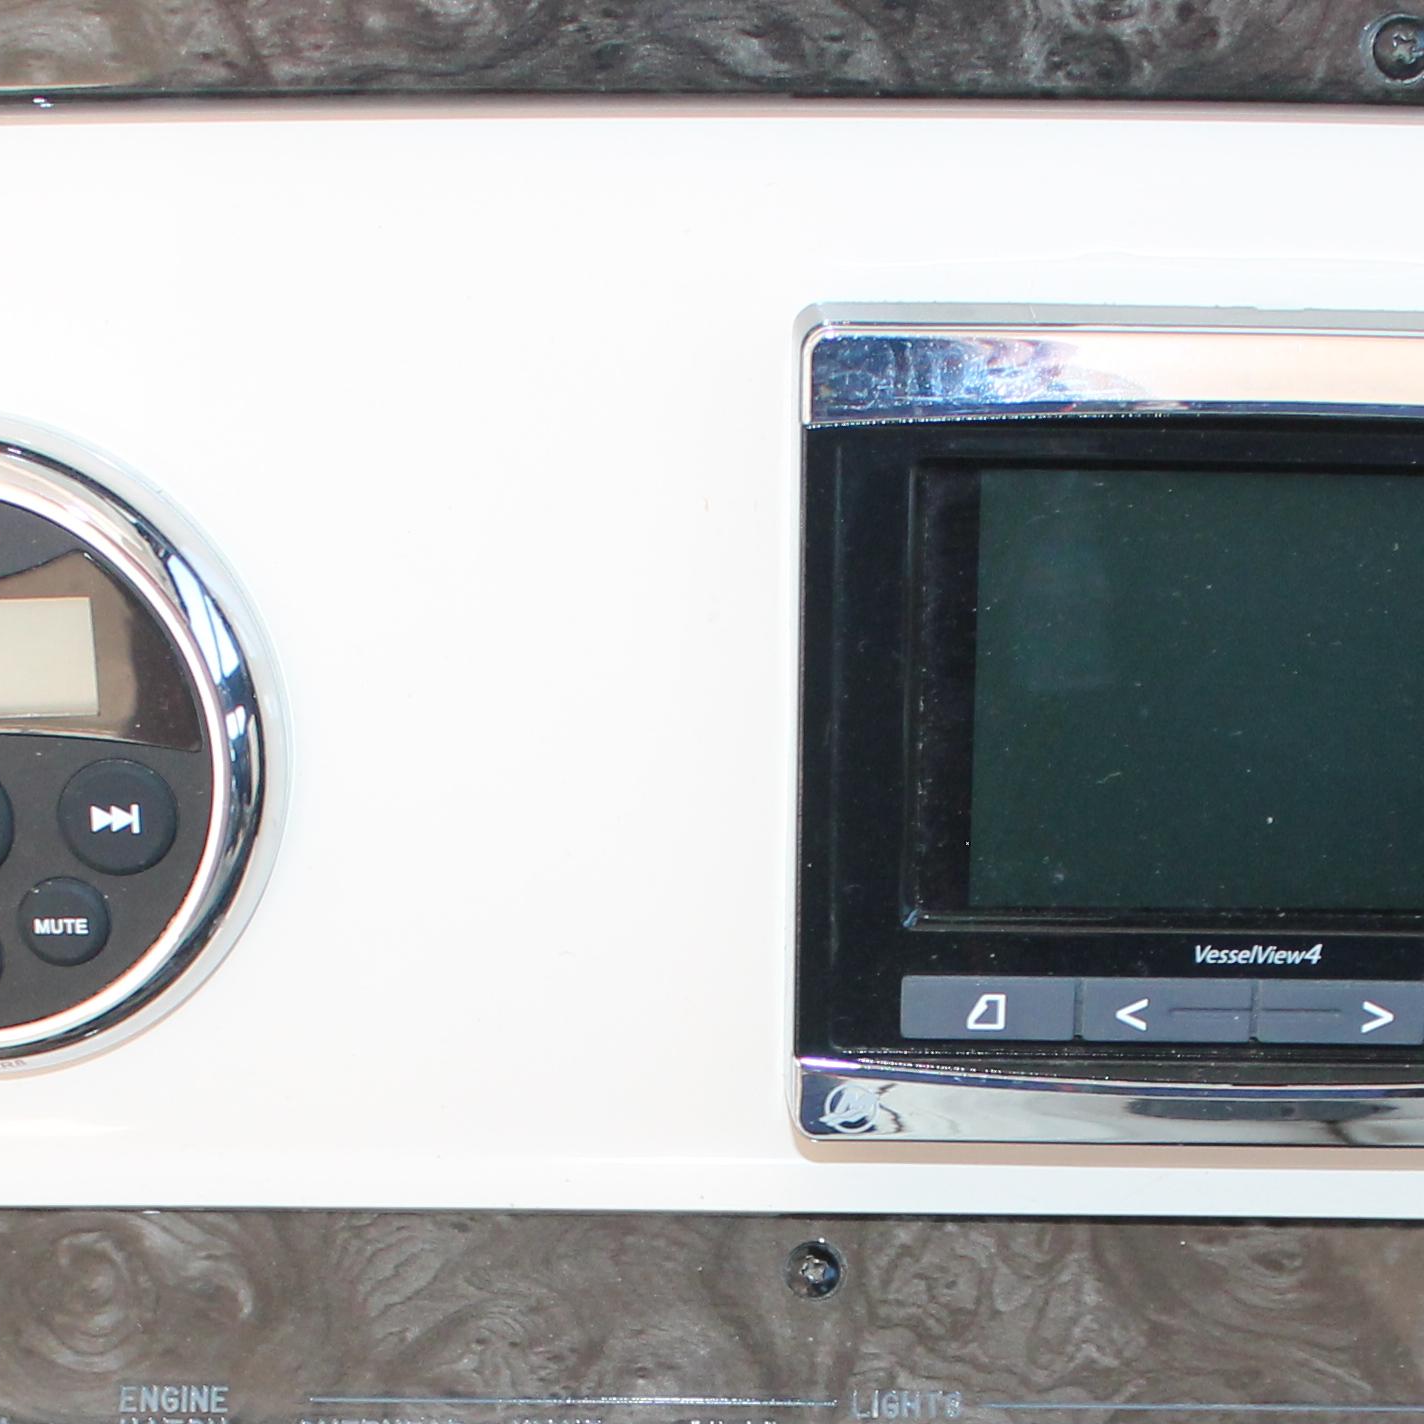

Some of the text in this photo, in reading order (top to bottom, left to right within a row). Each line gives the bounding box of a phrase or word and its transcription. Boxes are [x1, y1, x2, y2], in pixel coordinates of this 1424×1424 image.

[33, 918, 88, 935] MUTE
[1194, 943, 1323, 965] VesselView4
[119, 1385, 229, 1414] ENGINE
[850, 1390, 962, 1419] LIGHTS
